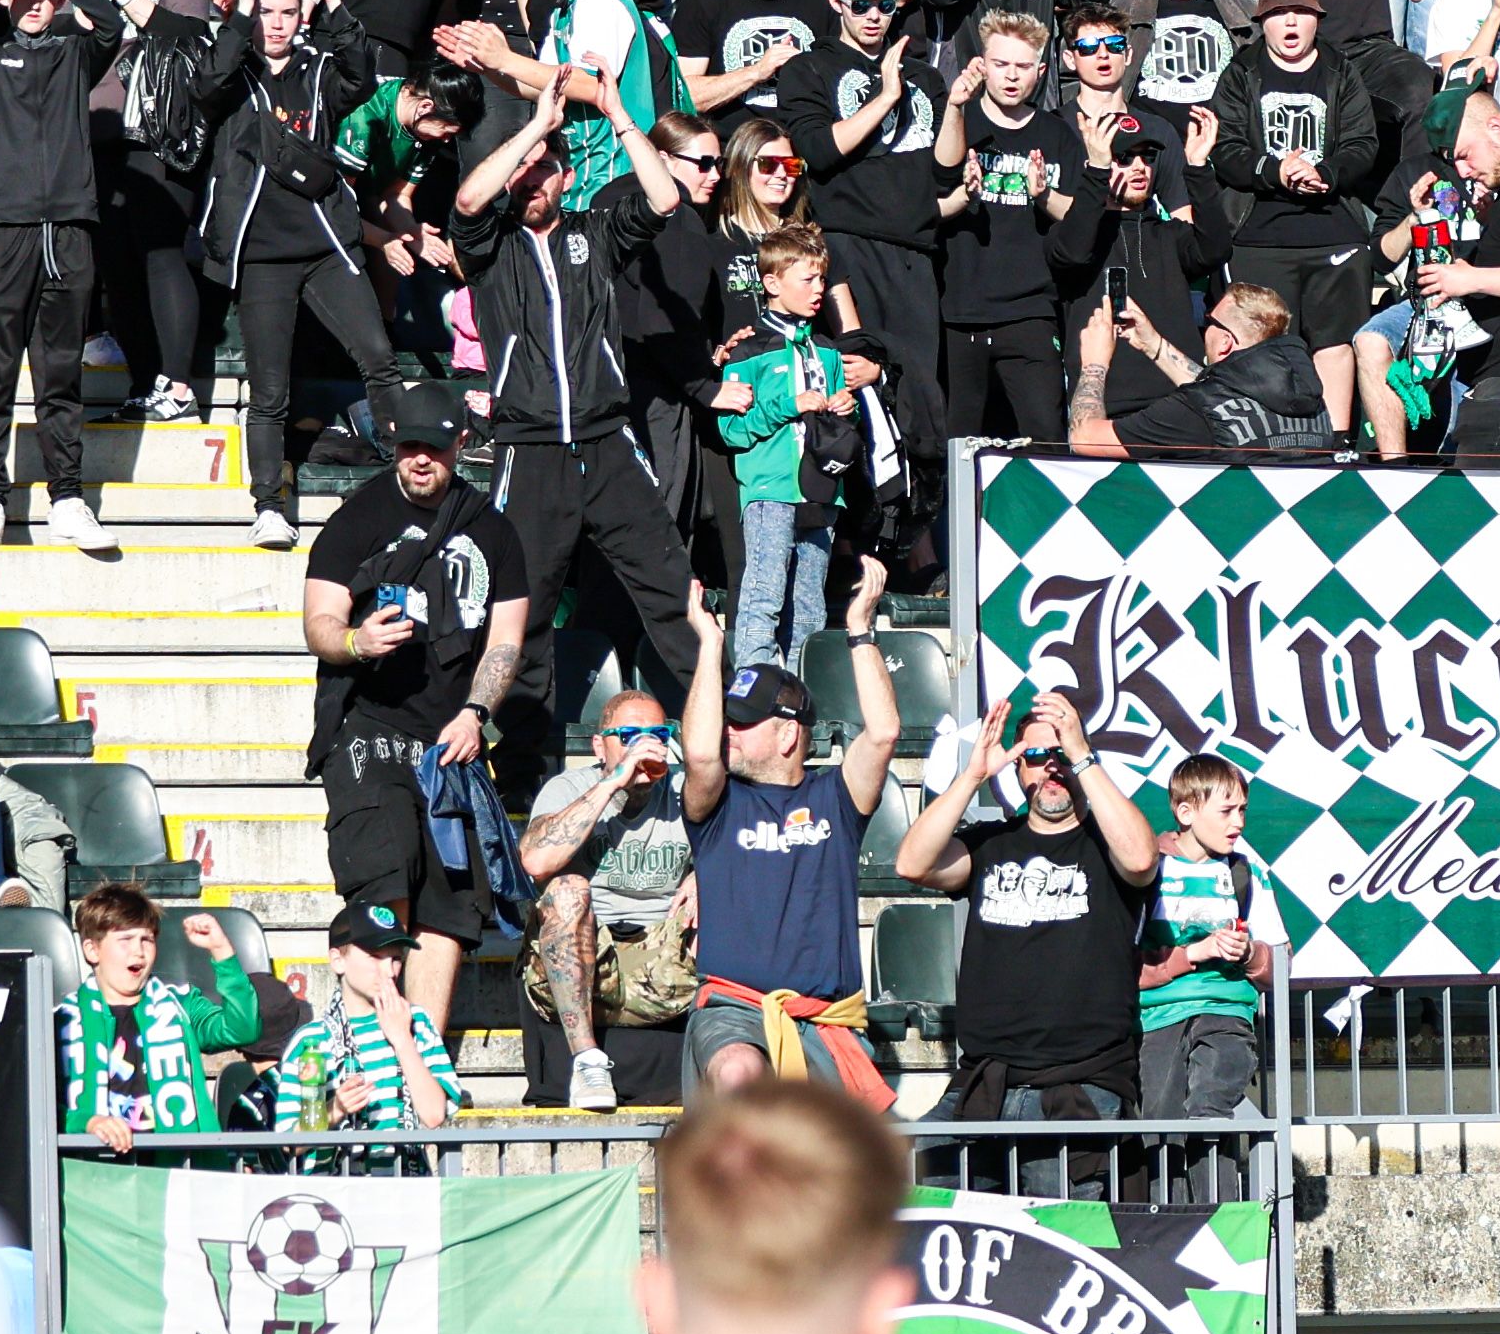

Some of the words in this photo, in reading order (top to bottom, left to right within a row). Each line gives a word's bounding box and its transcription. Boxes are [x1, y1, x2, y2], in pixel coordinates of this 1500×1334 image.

[204, 438, 226, 483] 7
[737, 819, 832, 854] ellesse
[924, 1225, 1013, 1310] OF
